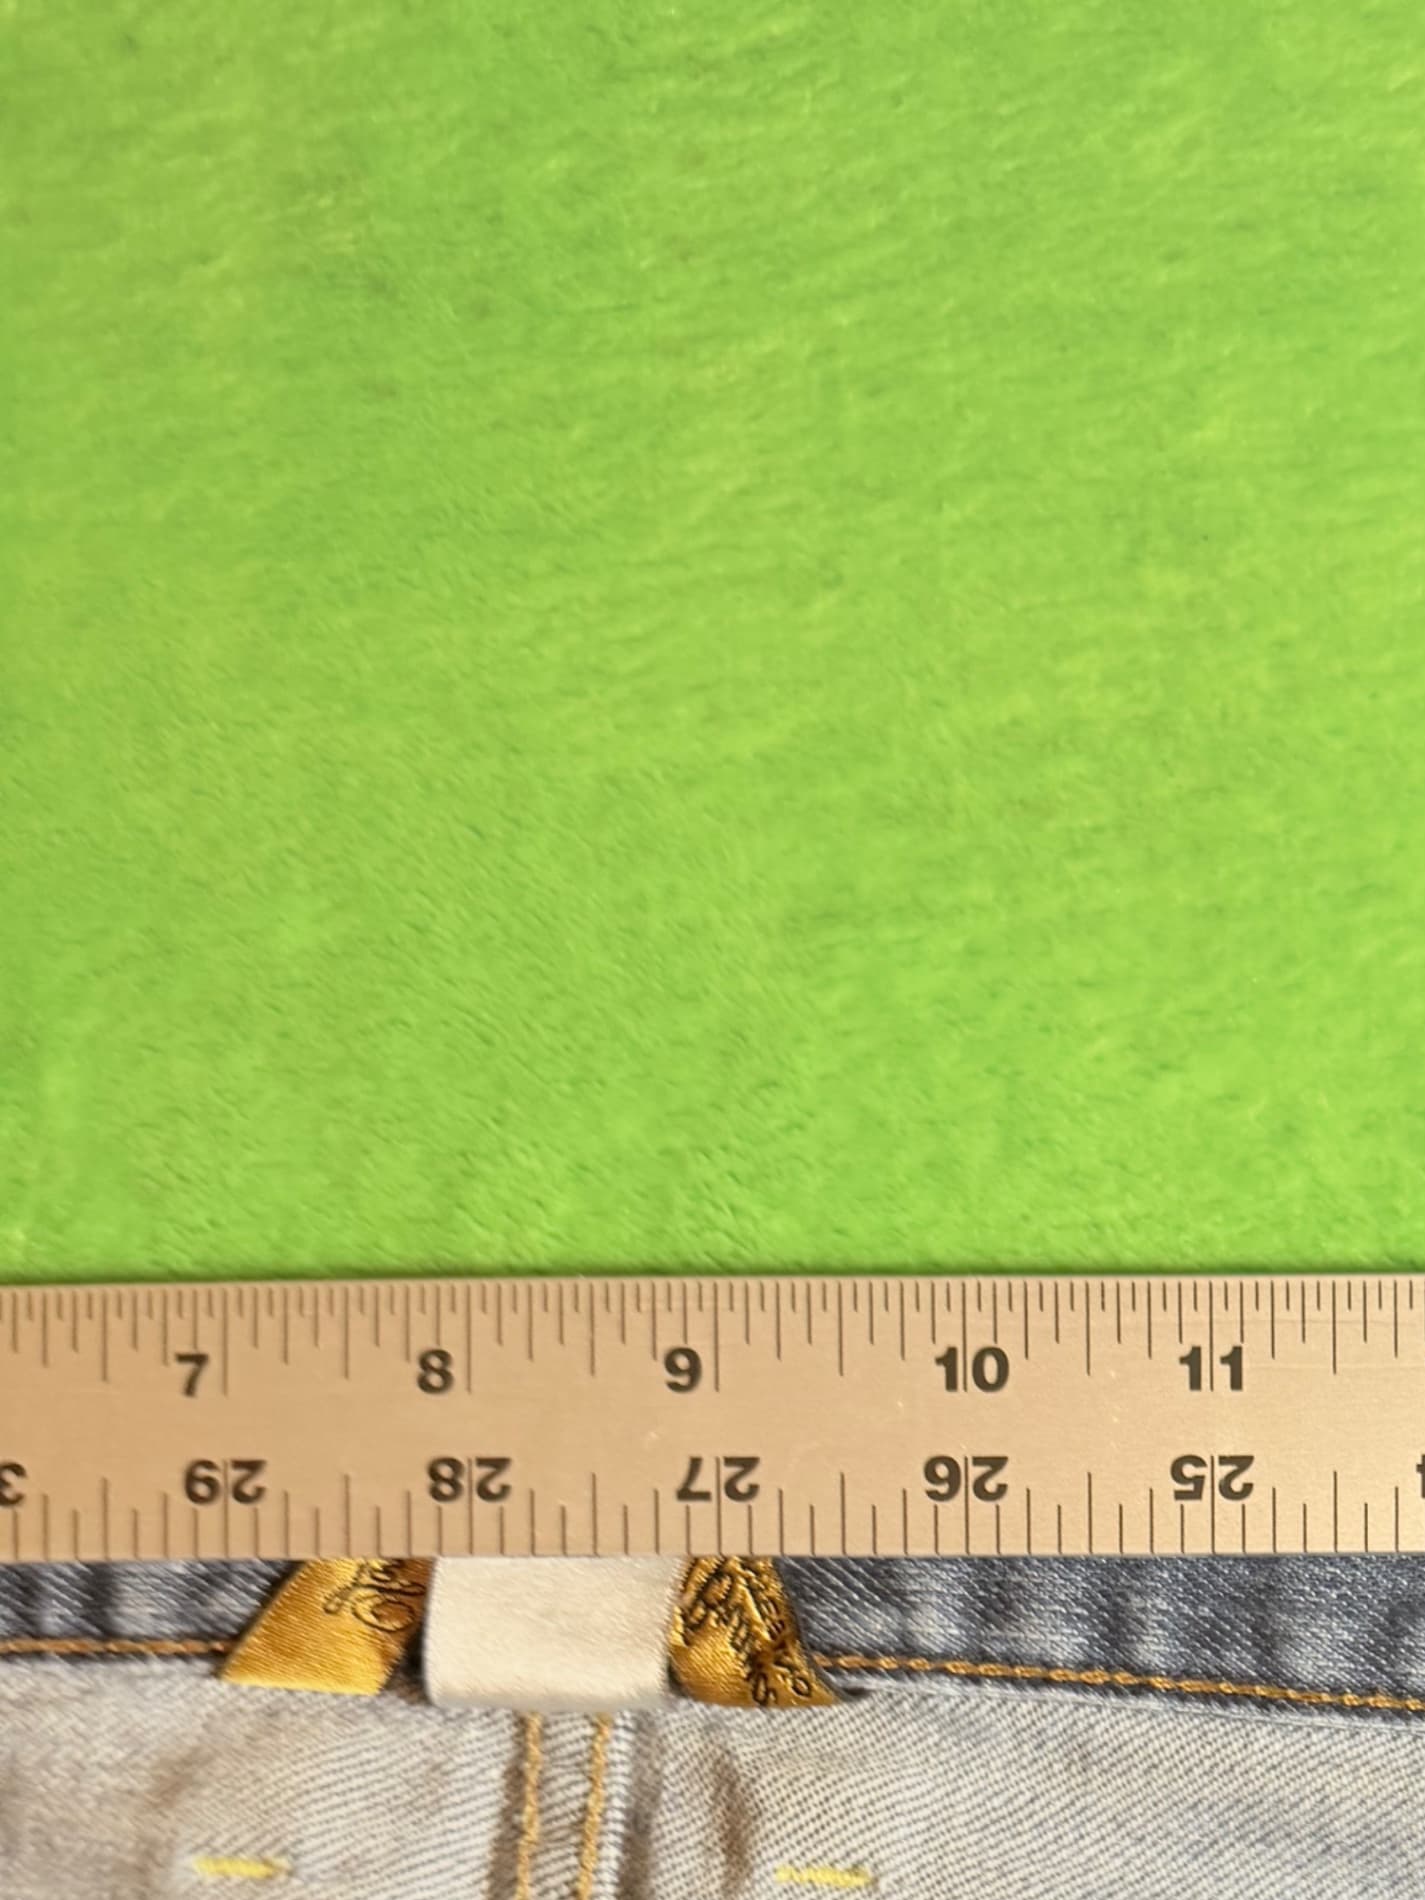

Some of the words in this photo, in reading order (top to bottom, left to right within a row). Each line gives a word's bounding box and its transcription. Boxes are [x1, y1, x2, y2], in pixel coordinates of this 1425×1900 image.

[173, 1351, 211, 1399] 7
[415, 1347, 455, 1396] 8
[662, 1345, 704, 1395] 9
[933, 1344, 1011, 1394] 10
[1177, 1343, 1245, 1393] 11
[181, 1457, 267, 1507] 29
[425, 1455, 513, 1504] 28
[674, 1454, 762, 1504] 27
[922, 1453, 1010, 1504] 26
[1168, 1452, 1256, 1504] 25
